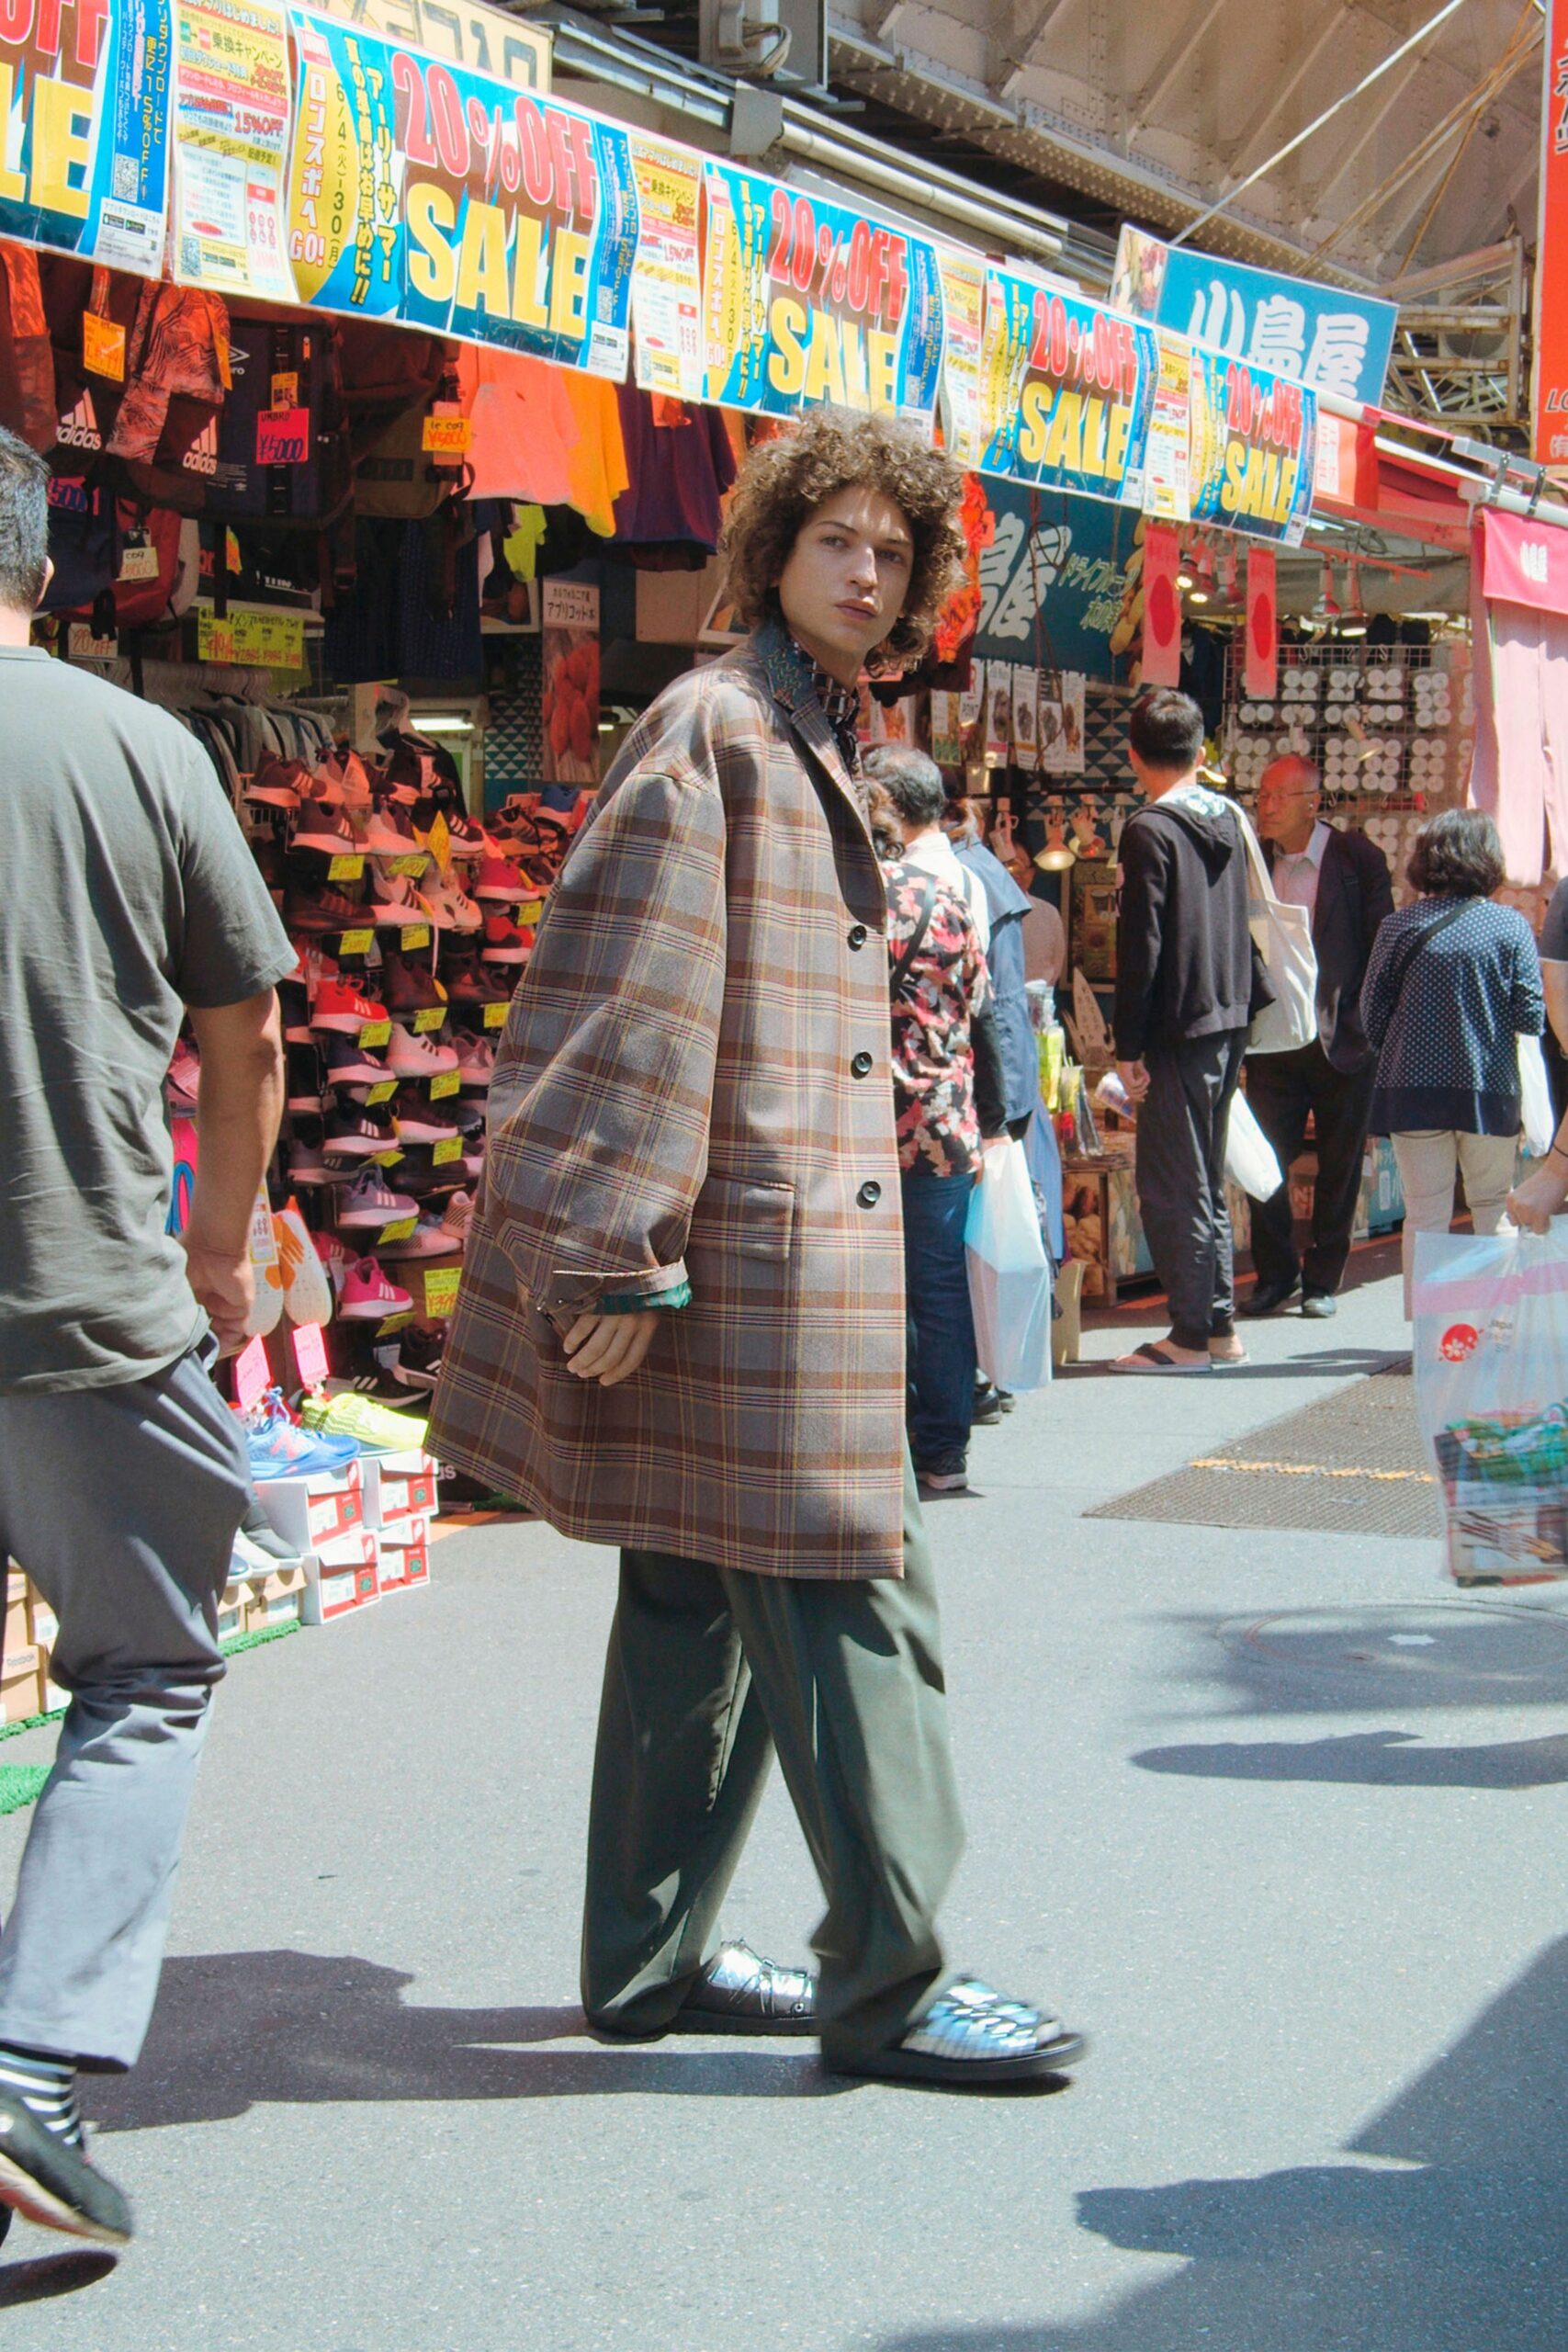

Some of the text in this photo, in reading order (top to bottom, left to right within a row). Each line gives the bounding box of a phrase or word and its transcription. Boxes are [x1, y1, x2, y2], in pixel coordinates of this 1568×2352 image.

[366, 65, 398, 283] アーリーサマー
[289, 229, 325, 268] GO!
[406, 182, 591, 340] SALE
[768, 297, 898, 417] SALE
[56, 424, 102, 451] didas
[183, 450, 218, 476] adidas
[1020, 381, 1133, 481] SALE
[1221, 440, 1297, 524] SALE
